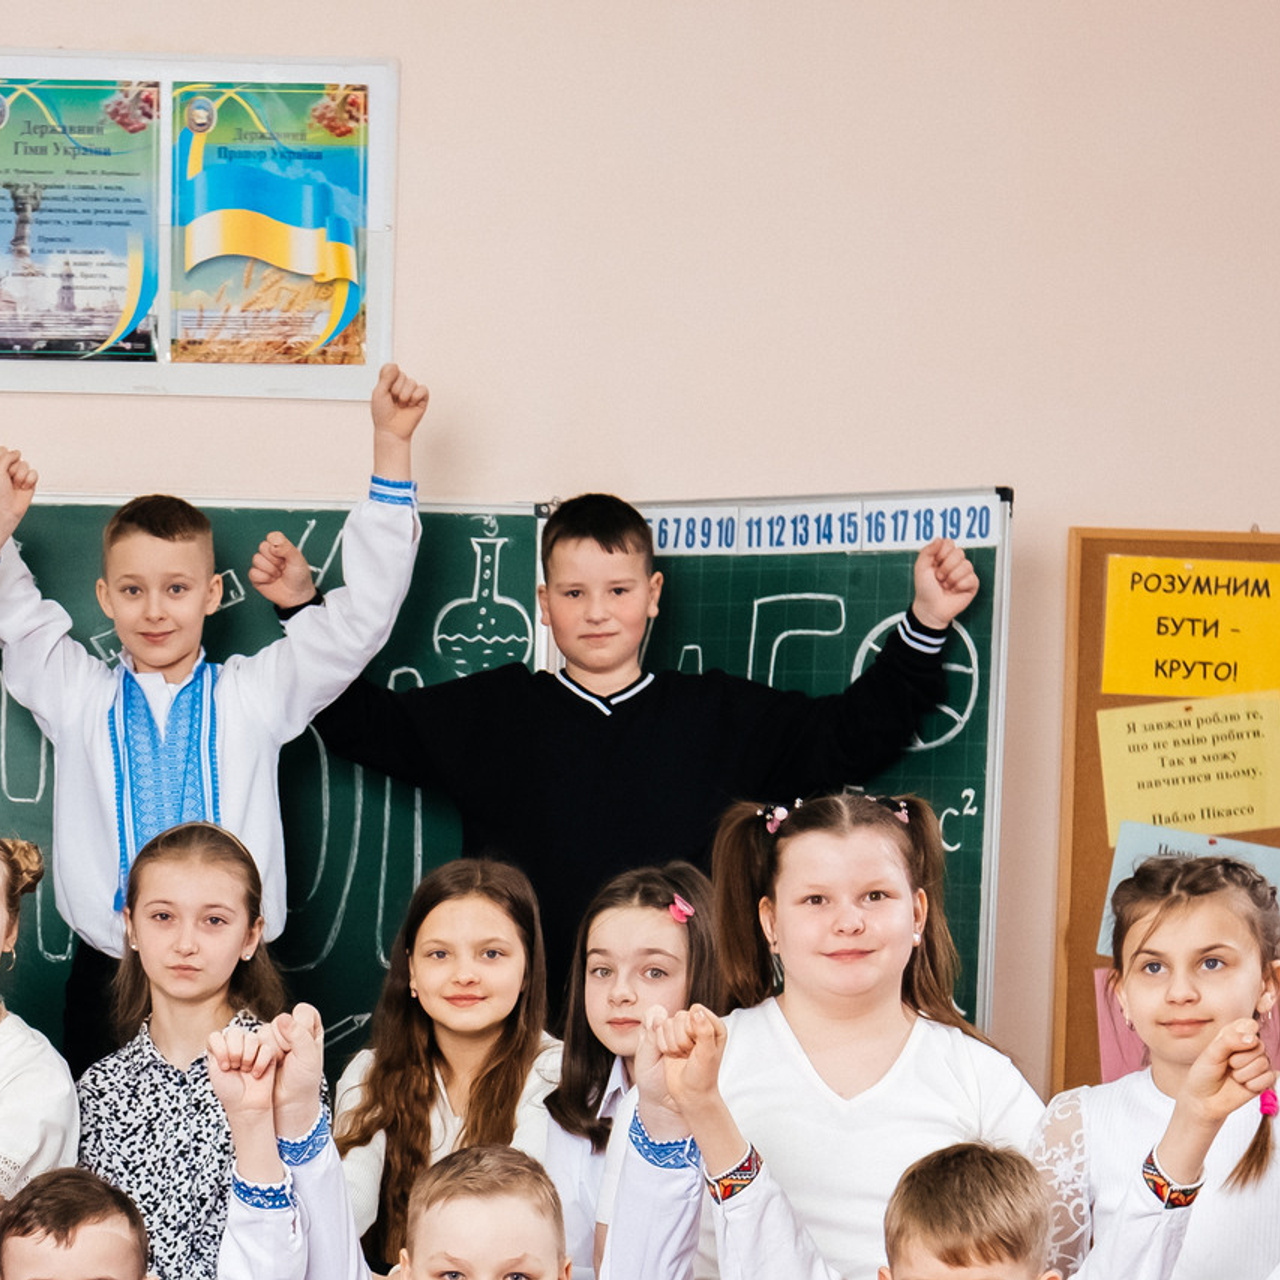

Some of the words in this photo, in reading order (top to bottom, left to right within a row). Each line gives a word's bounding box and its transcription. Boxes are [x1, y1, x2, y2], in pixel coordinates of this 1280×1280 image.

[20, 120, 105, 138] Державний
[13, 141, 48, 156] Гімн
[52, 142, 112, 160] України
[217, 146, 266, 163] Прапор
[270, 147, 323, 163] України
[658, 518, 669, 549] 6
[673, 518, 681, 548] 7
[685, 517, 696, 548] 8
[700, 517, 712, 548] 9
[717, 516, 735, 548] 10
[745, 516, 762, 548] 11
[767, 515, 785, 547] 12
[791, 514, 809, 546] 13
[814, 513, 832, 545] 14
[838, 512, 858, 544] 15
[865, 510, 886, 543] 16
[891, 509, 909, 542] 17
[913, 508, 934, 541] 18
[940, 506, 961, 539] 19
[966, 505, 990, 539] 20
[1130, 572, 1270, 598] РОЗУМНИМ
[1156, 616, 1219, 638] БУТИ
[1154, 659, 1238, 682] КРУТО!
[1127, 722, 1136, 734] Я
[1143, 718, 1192, 733] завжди
[1196, 712, 1241, 729] роблю
[1153, 741, 1168, 750] не
[1173, 734, 1207, 748] вмію
[1159, 756, 1185, 768] Так
[1189, 756, 1197, 765] я
[1202, 751, 1238, 763] можу
[1137, 774, 1212, 790] навчитися
[1152, 811, 1196, 826] Пабло
[1200, 805, 1255, 820] Пікассо
